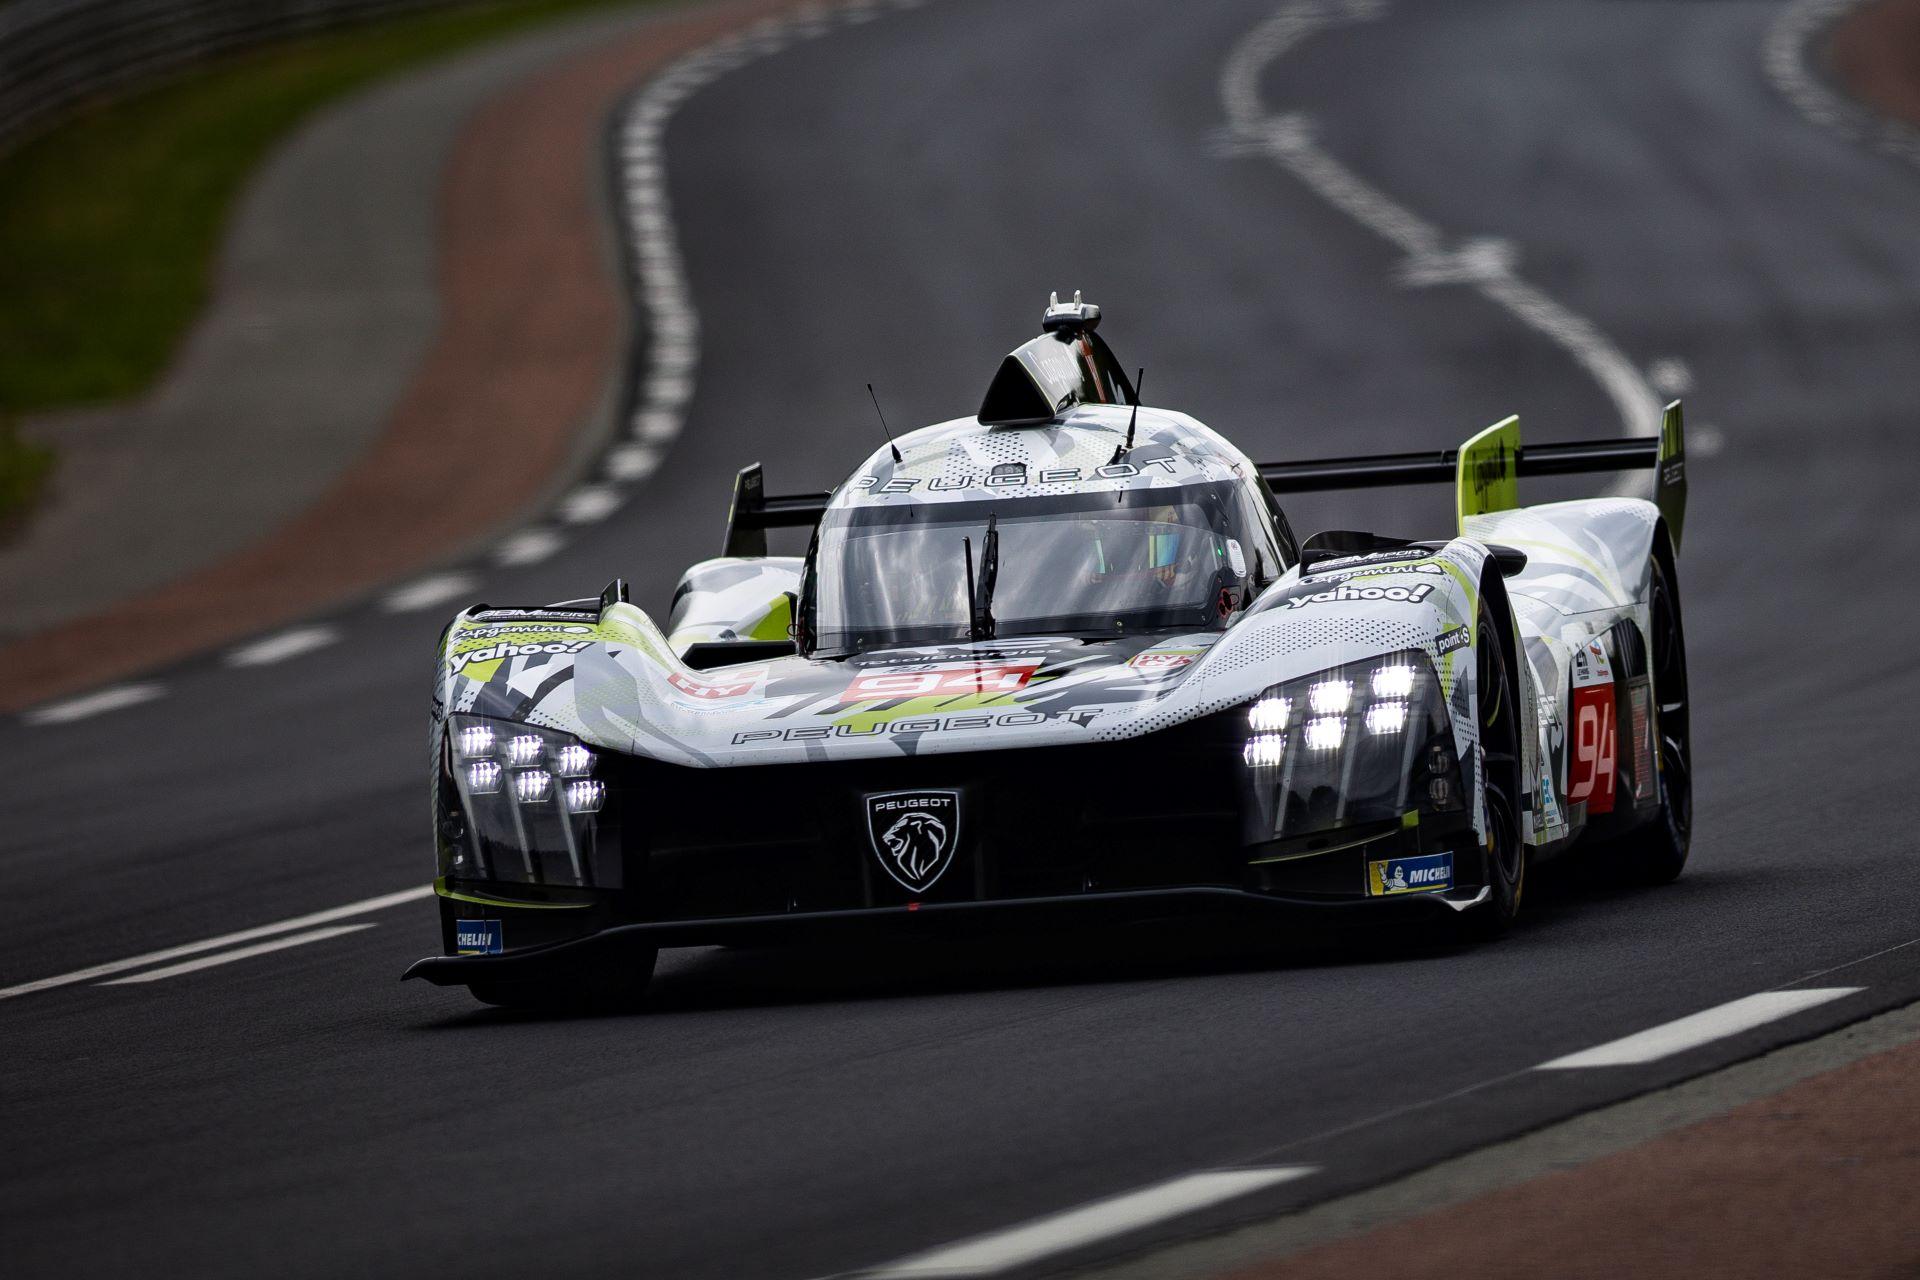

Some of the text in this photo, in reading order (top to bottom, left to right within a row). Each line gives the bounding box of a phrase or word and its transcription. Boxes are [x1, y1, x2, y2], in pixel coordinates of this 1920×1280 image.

[847, 457, 1177, 494] PEUGEOT
[1300, 566, 1415, 586] Capgemini
[1287, 584, 1435, 609] yahoo!
[450, 625, 561, 642] Capgemini
[1438, 633, 1461, 650] point
[450, 640, 595, 676] yahoo!
[855, 666, 1029, 697] 94
[731, 708, 1104, 745] PEUGEOT
[1570, 702, 1614, 797] 94
[875, 798, 951, 812] PEUGEOT
